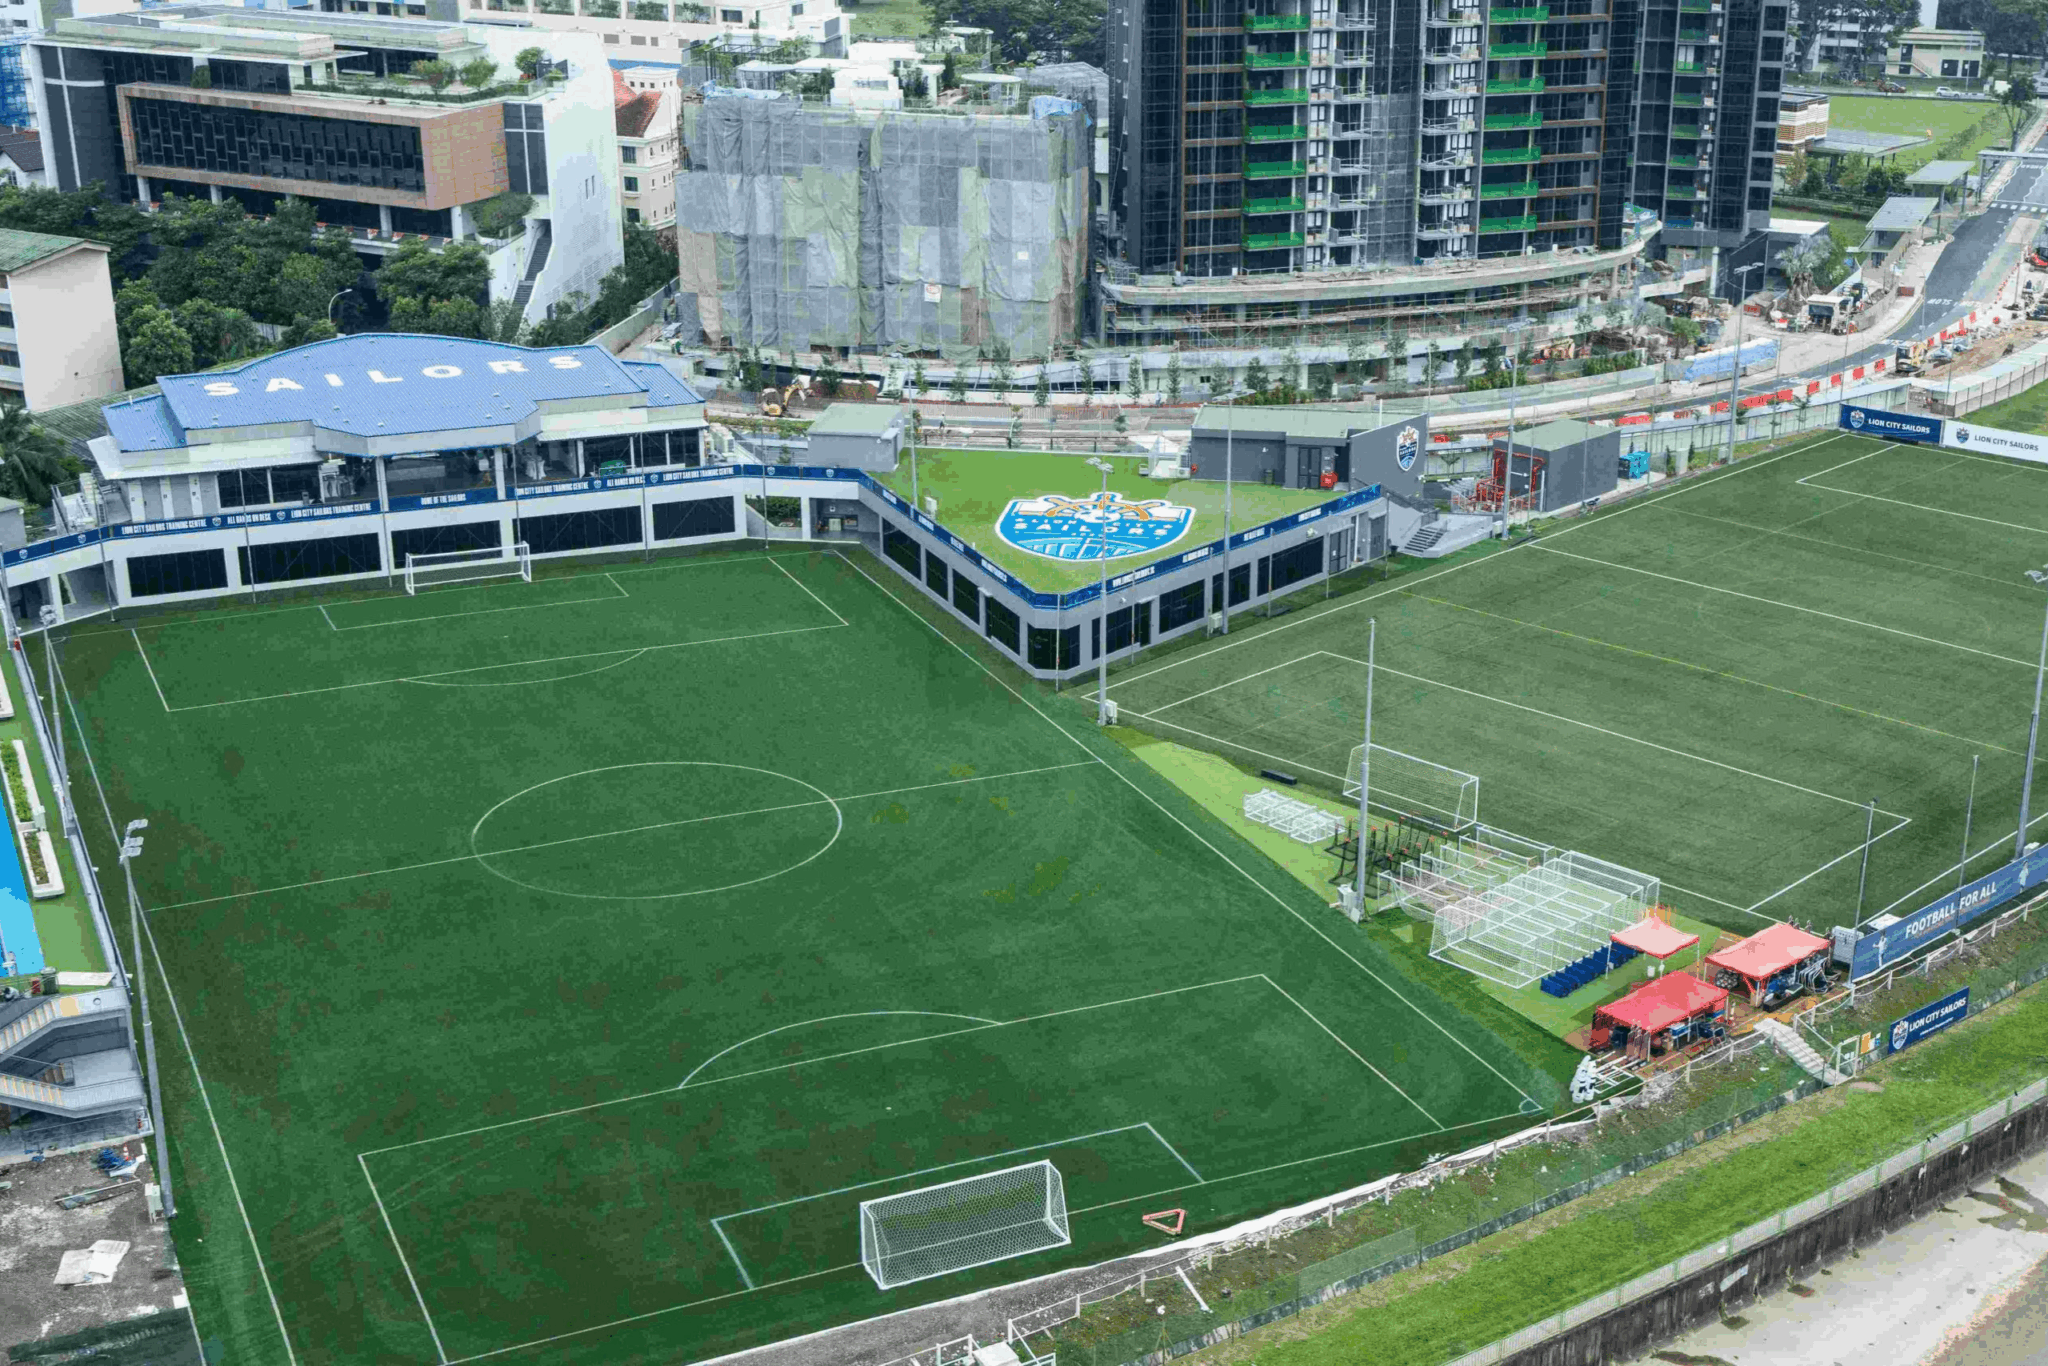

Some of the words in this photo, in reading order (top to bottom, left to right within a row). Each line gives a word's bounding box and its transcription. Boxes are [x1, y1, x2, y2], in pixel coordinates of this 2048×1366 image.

[204, 356, 583, 397] SAILORS
[1868, 419, 1884, 427] LION
[1886, 421, 1901, 430] CITY
[1901, 423, 1930, 434] SAILORS
[1974, 435, 1991, 444] LION
[1992, 437, 2008, 446] CITY
[2009, 441, 2039, 451] SAILORS
[1013, 522, 1168, 536] SAILORS
[1905, 902, 1956, 939] FOOTBALL
[1959, 890, 1978, 910] FOR
[1979, 881, 1997, 900] ALL
[1909, 1017, 1925, 1032] LION
[1925, 1009, 1940, 1024] CITY
[1940, 997, 1967, 1017] SAILORS
